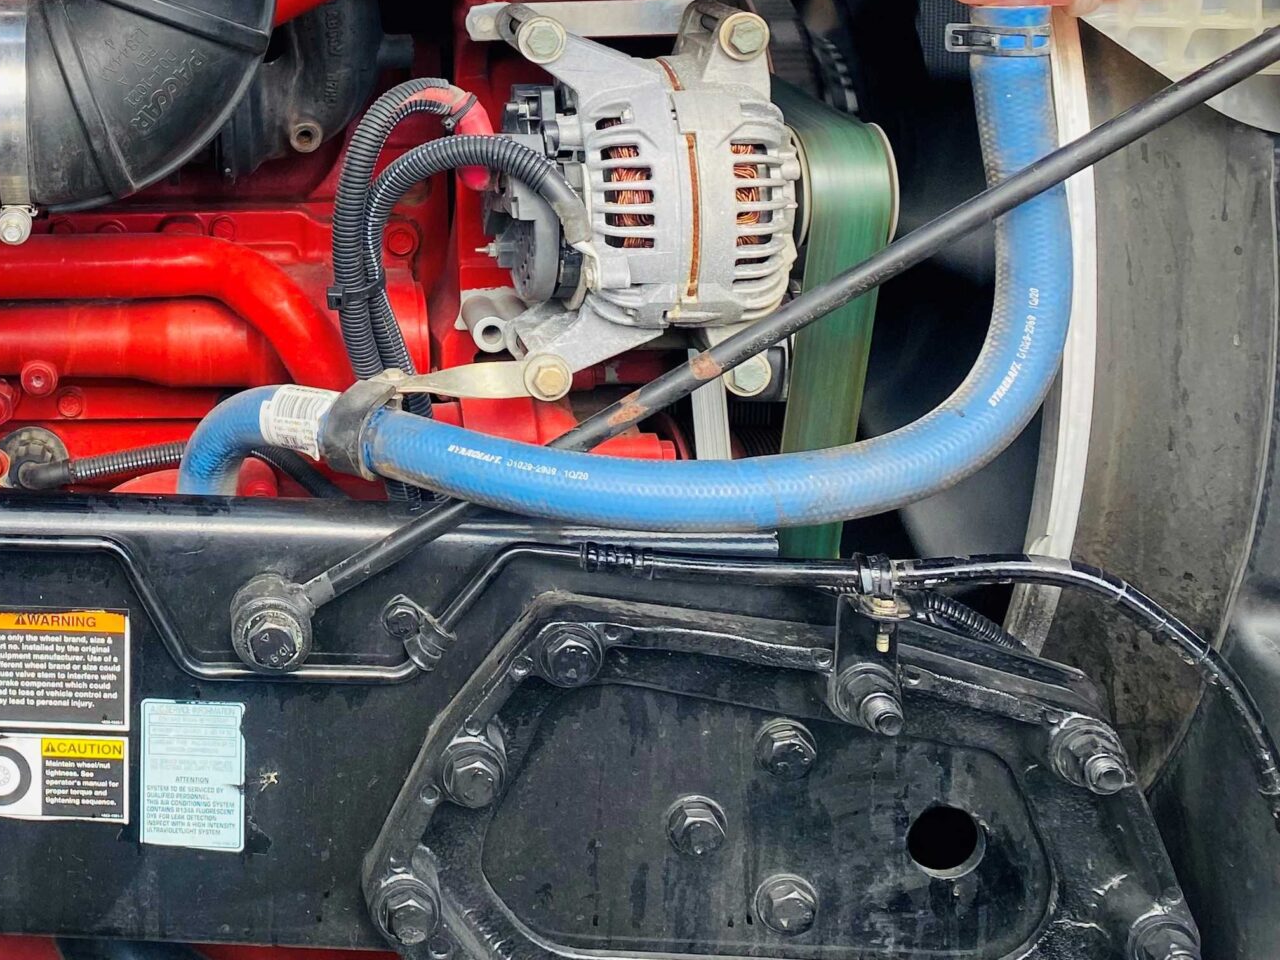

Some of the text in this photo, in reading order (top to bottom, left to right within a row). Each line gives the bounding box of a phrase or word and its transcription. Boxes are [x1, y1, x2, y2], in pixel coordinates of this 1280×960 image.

[130, 48, 207, 131] PACCAR
[27, 614, 96, 627] WARNING
[8, 634, 24, 643] only
[56, 644, 65, 652] by
[81, 646, 110, 654] original
[36, 699, 69, 707] personal
[71, 700, 94, 708] injury.
[57, 743, 121, 755] CAUTION
[77, 761, 110, 769] wheel/nut
[46, 769, 79, 777] tightness.
[46, 779, 81, 787] operator's
[46, 797, 80, 805] tightening
